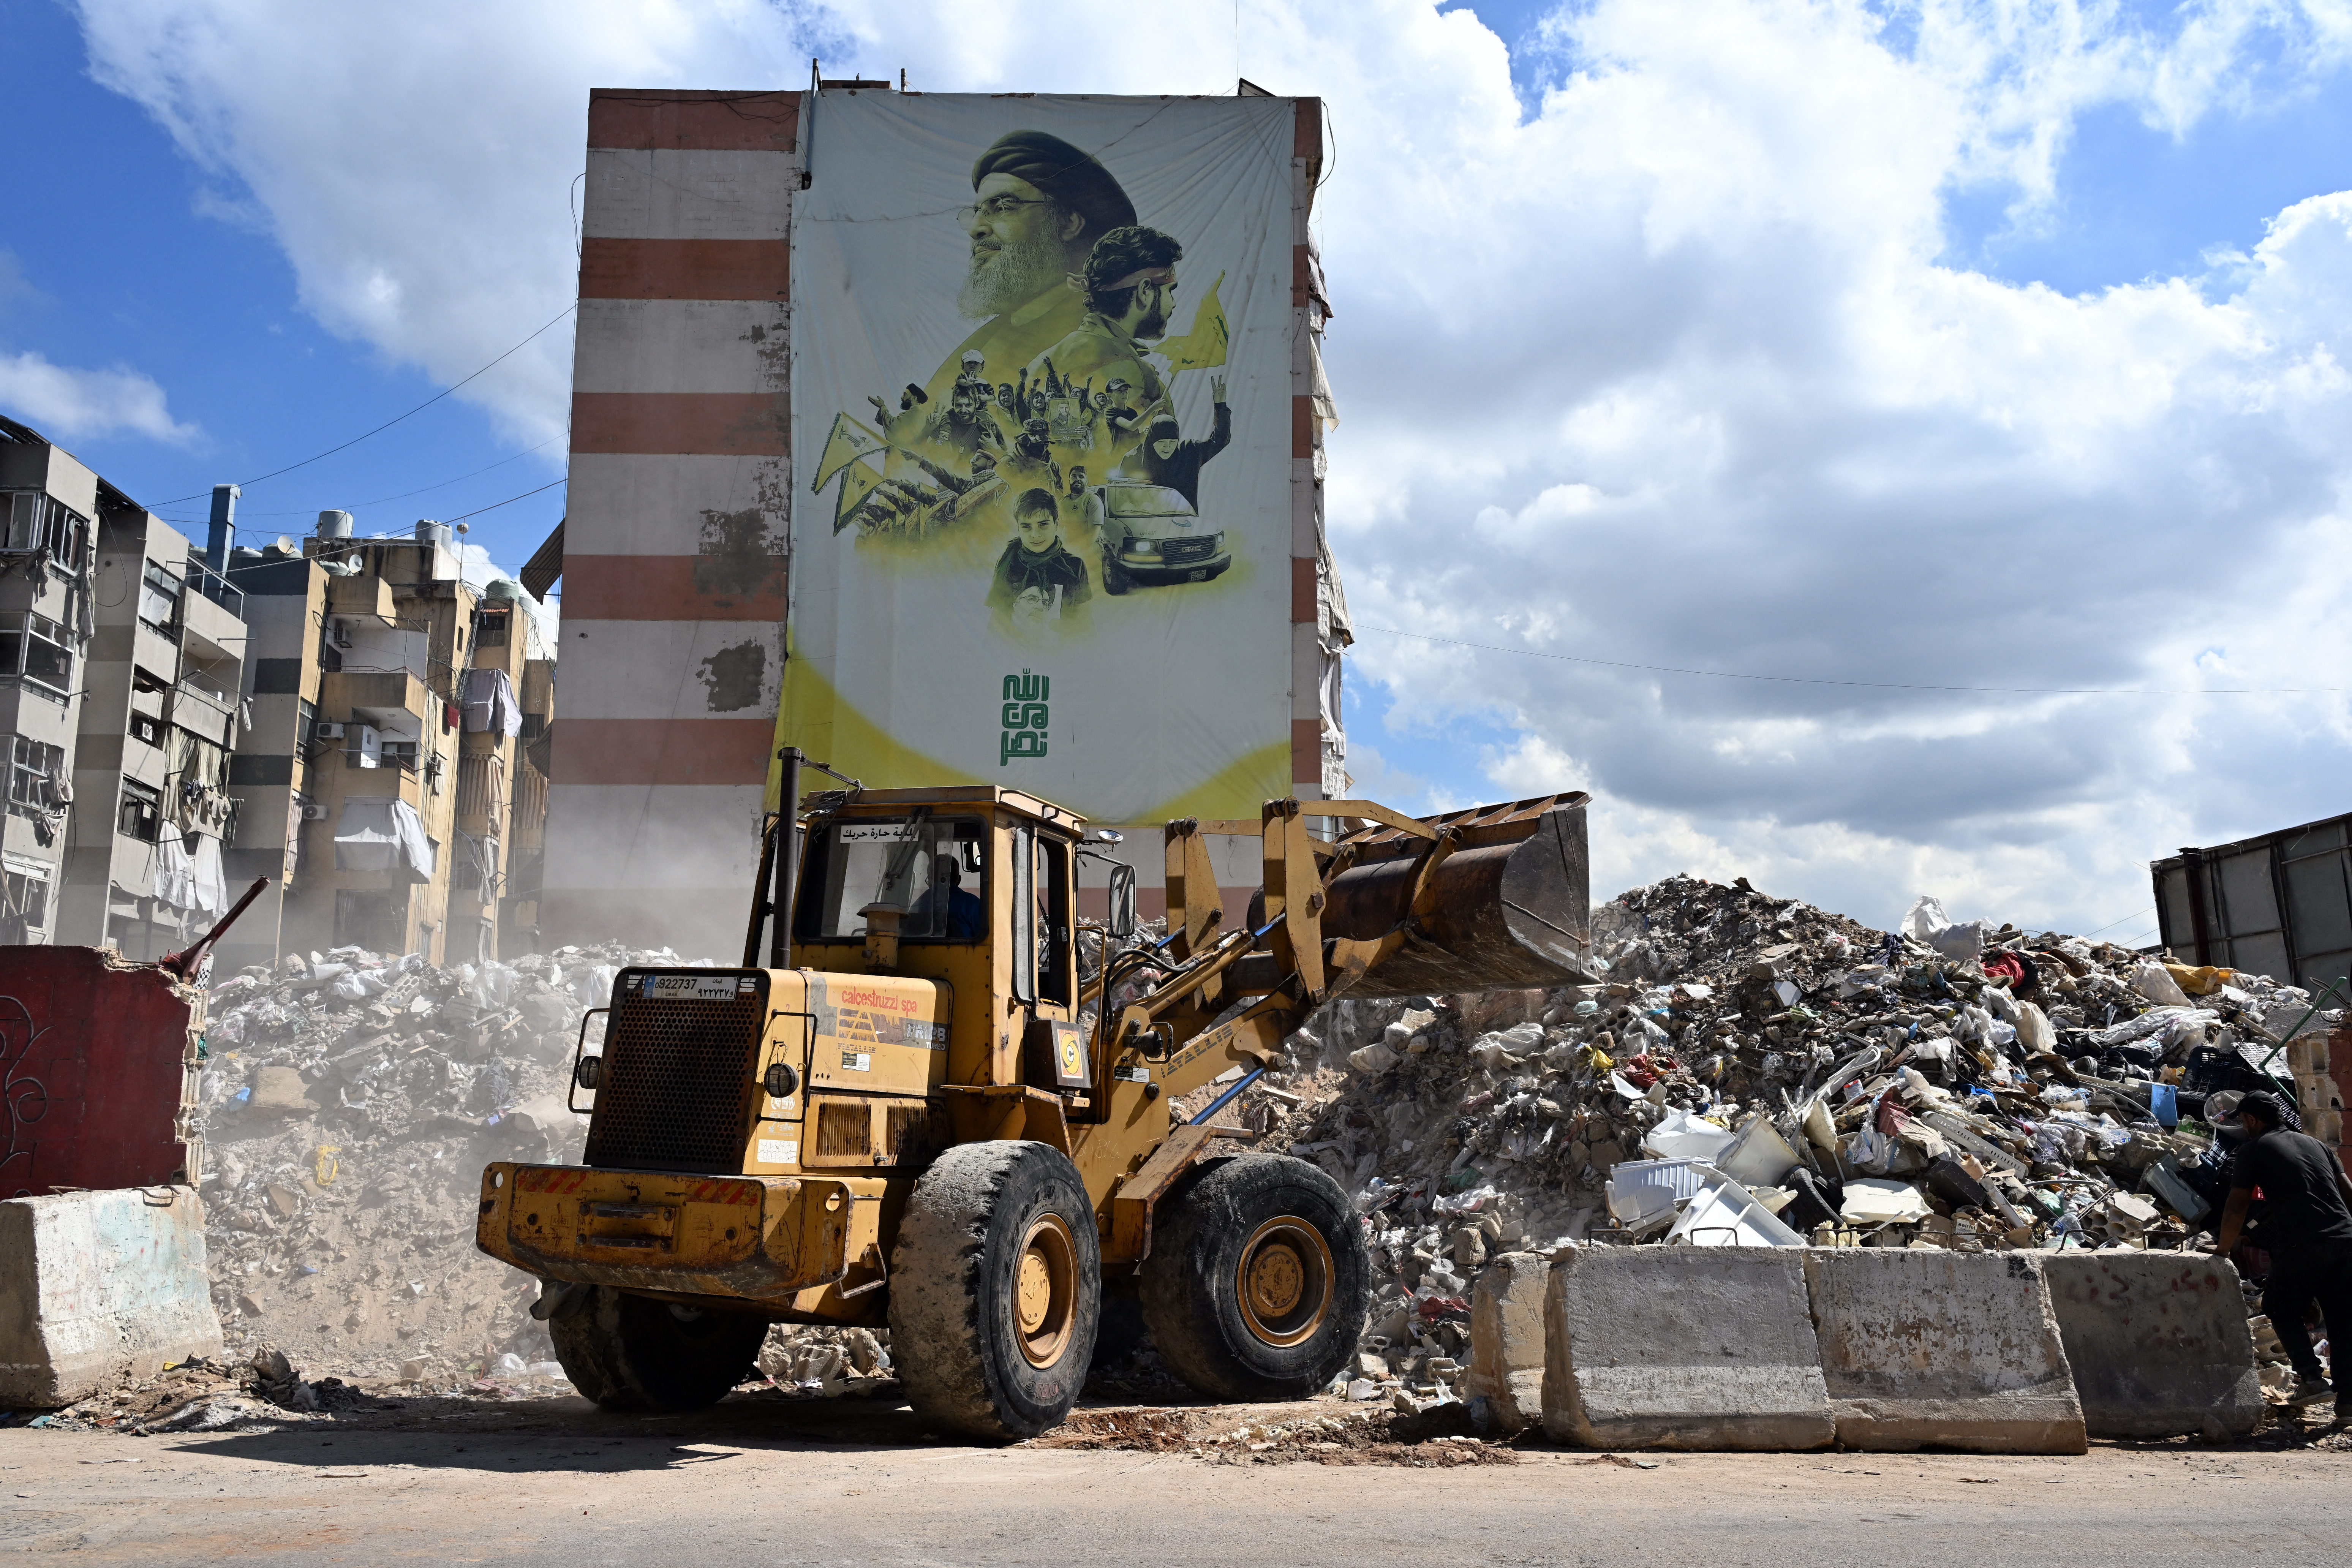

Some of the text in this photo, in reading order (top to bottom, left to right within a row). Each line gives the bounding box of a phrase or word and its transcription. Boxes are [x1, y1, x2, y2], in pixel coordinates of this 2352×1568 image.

[843, 829, 868, 839] حريك
[870, 828, 890, 839] حارة
[841, 986, 917, 1018] calcestruzzi spa
[926, 1042, 945, 1050] TURBO
[1063, 1208, 1080, 1240] TUBELESS
